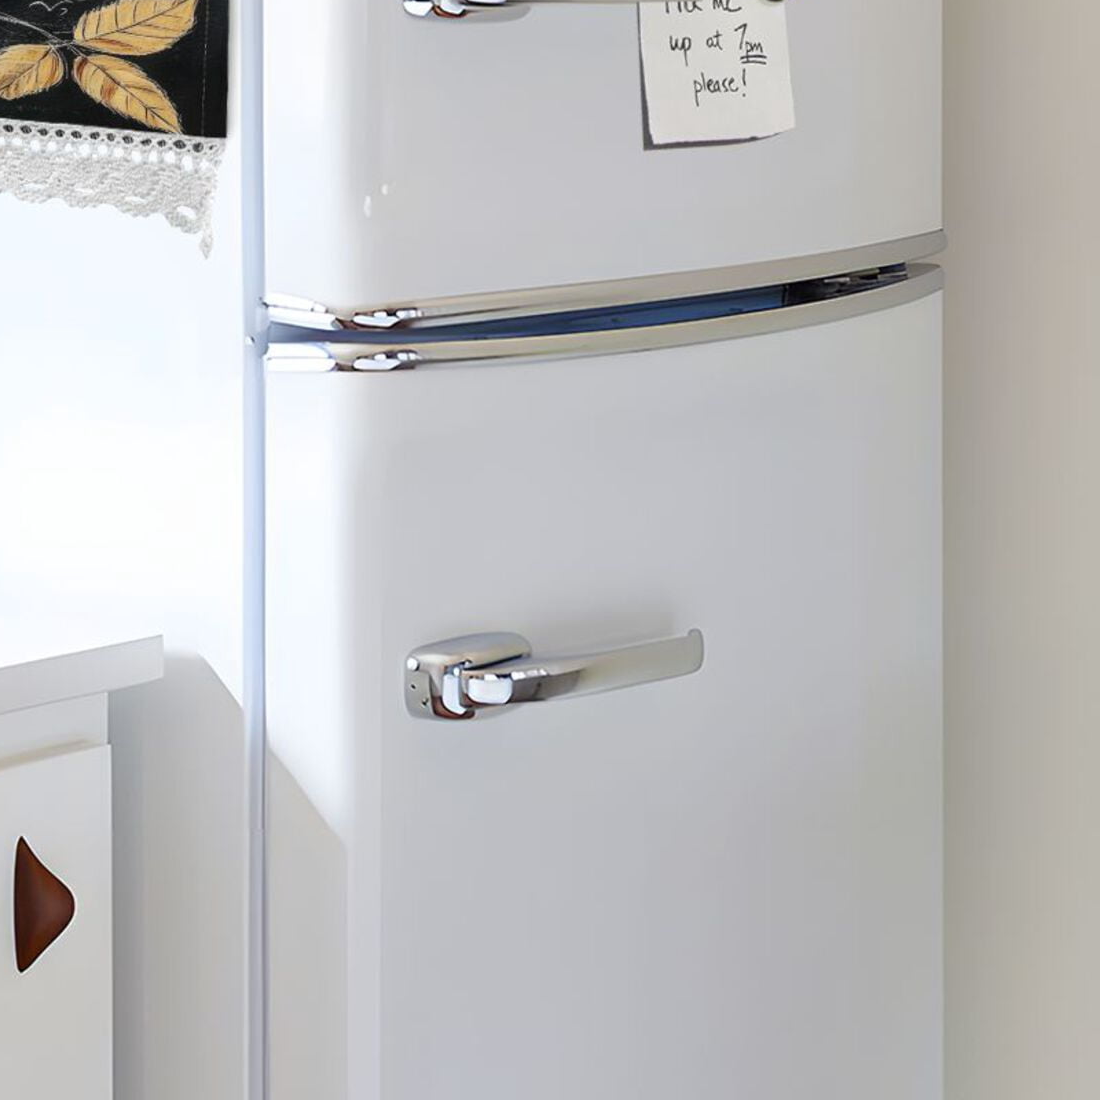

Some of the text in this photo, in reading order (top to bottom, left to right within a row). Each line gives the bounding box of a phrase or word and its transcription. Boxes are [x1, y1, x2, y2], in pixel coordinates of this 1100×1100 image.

[669, 35, 692, 66] up
[705, 30, 723, 50] at
[693, 69, 747, 106] please!
